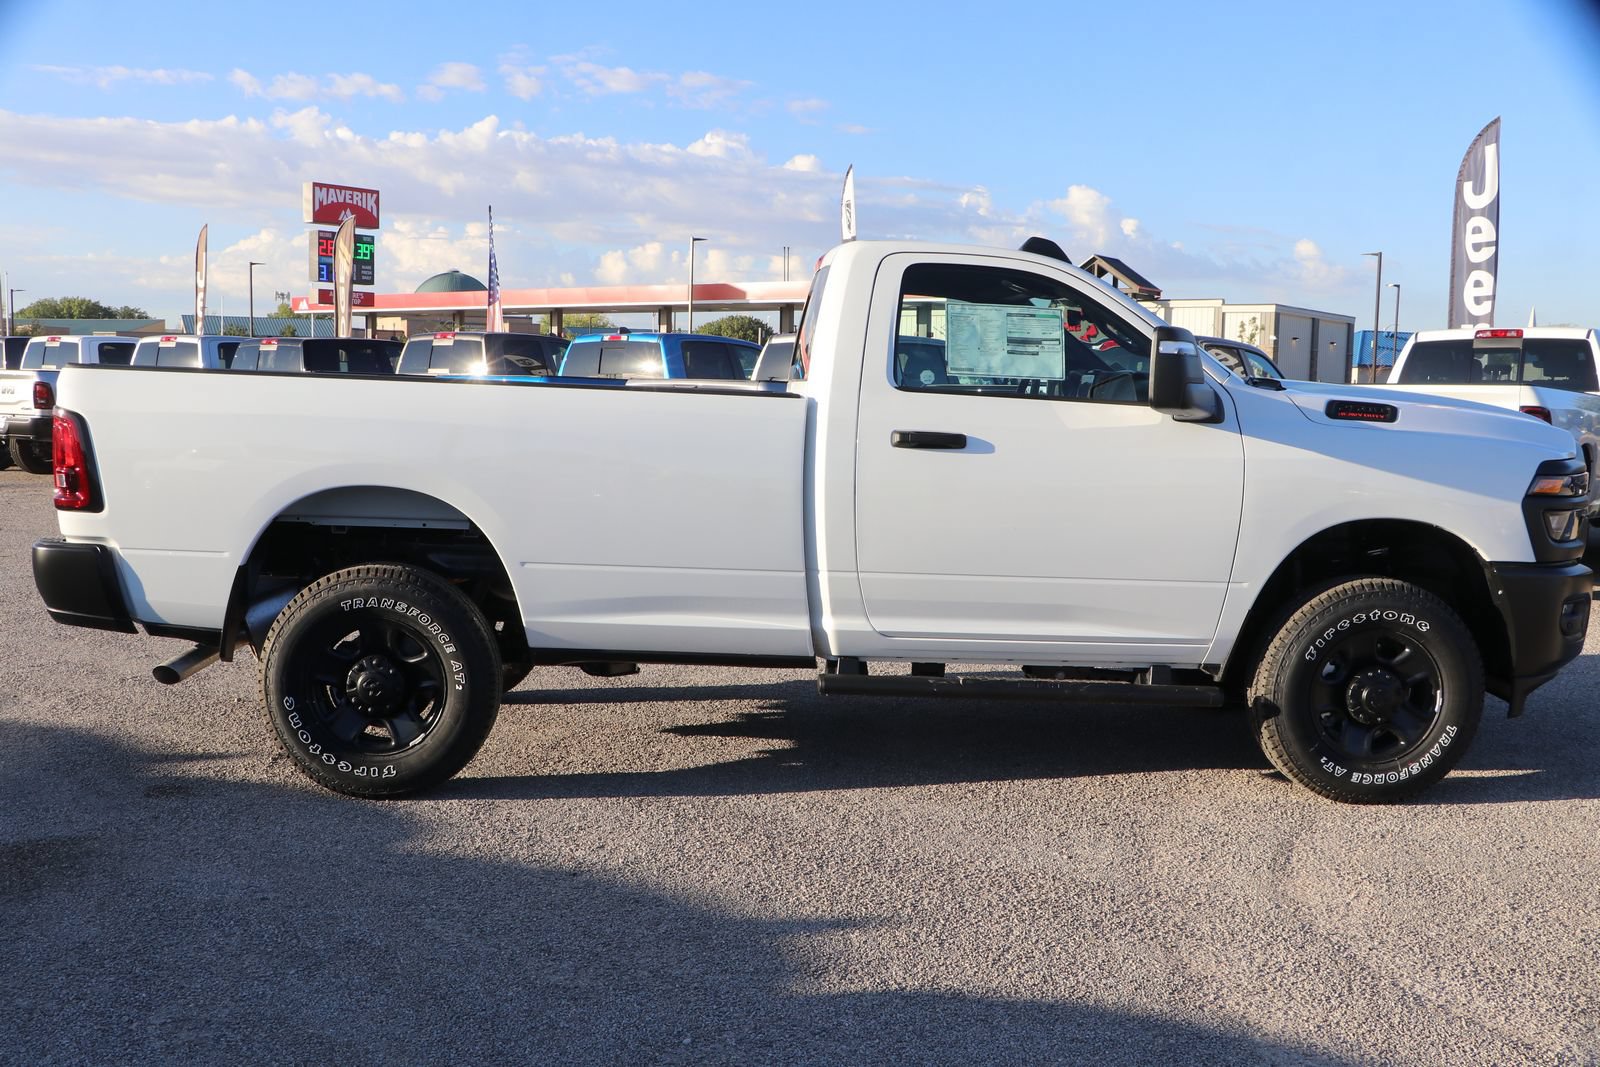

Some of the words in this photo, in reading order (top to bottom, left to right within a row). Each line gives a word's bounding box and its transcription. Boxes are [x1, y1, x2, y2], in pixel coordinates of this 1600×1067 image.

[314, 186, 378, 219] MAVERIK
[1463, 143, 1498, 328] Jee
[341, 597, 457, 654] TRANSFORCE
[1305, 609, 1430, 661] Firestone
[283, 696, 397, 779] Firestone
[1350, 724, 1458, 785] TRANSFORCE
